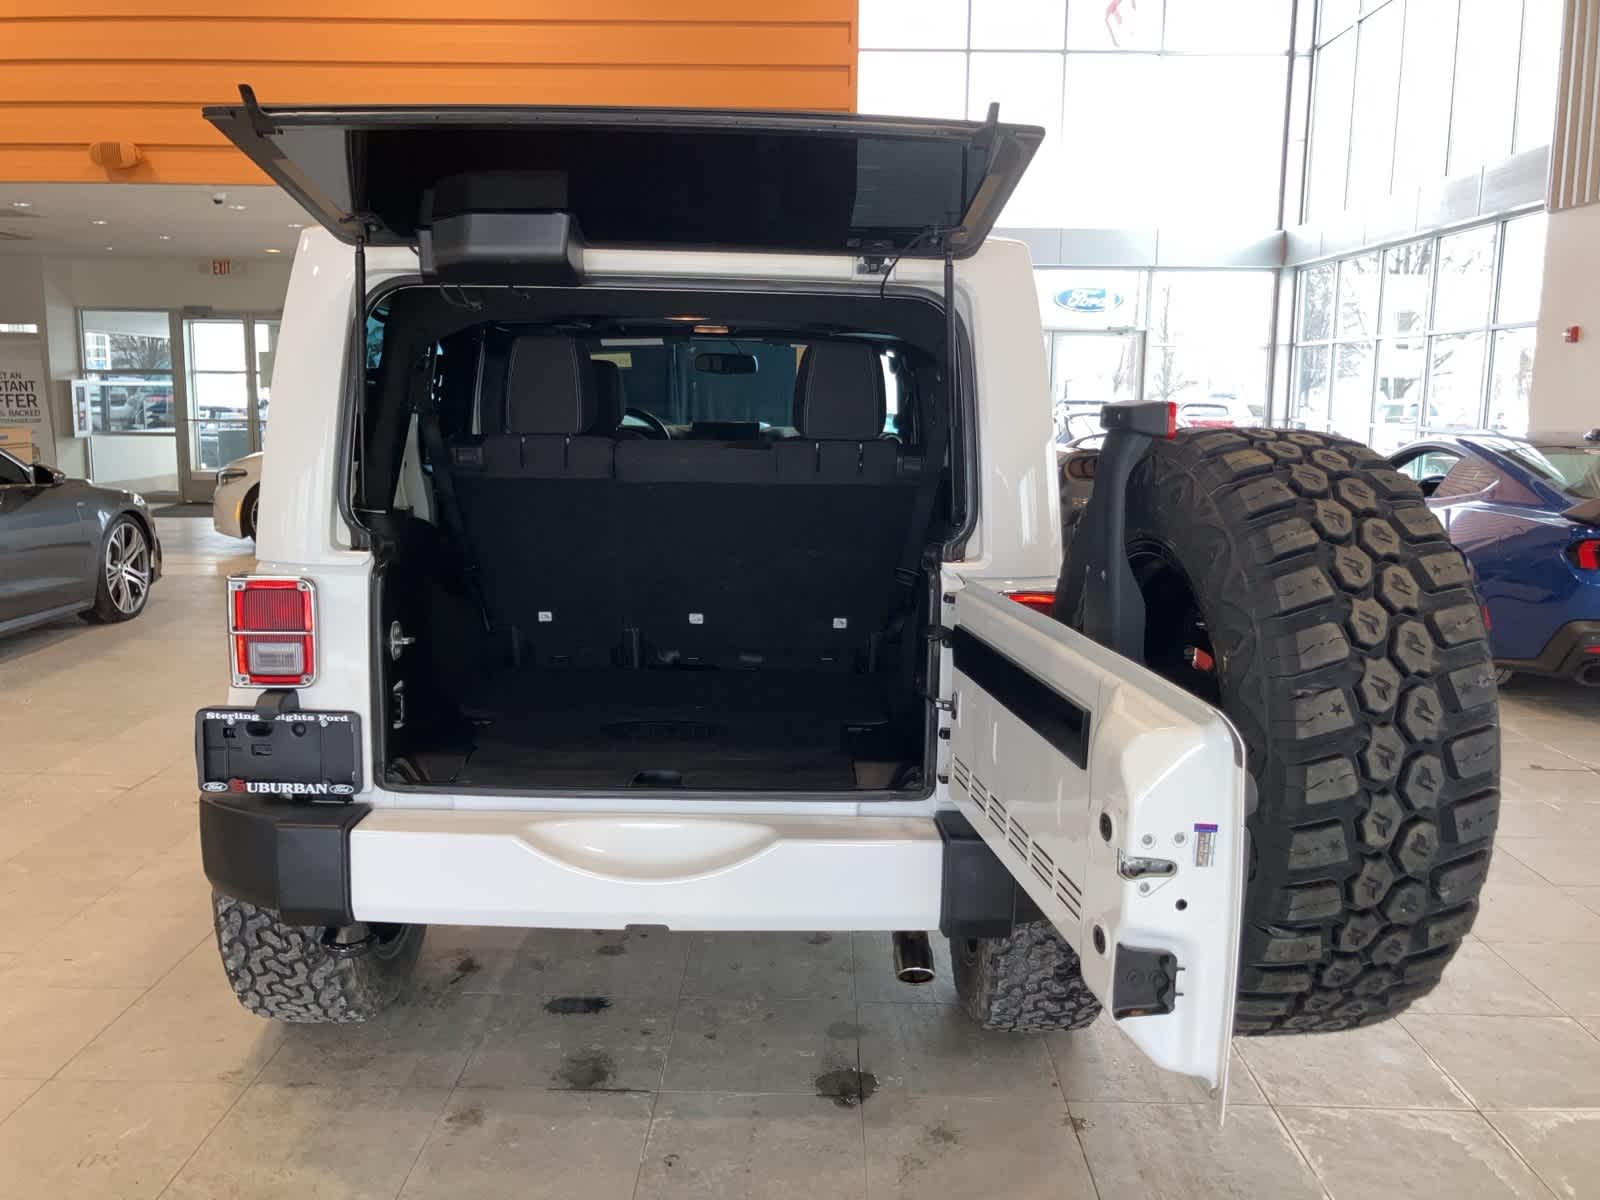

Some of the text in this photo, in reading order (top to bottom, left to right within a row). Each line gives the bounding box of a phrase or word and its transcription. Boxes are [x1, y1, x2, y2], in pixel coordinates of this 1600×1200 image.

[212, 260, 230, 275] EXIT
[206, 711, 349, 722] Sterling eights Ford
[230, 778, 328, 795] SUBURBAN
